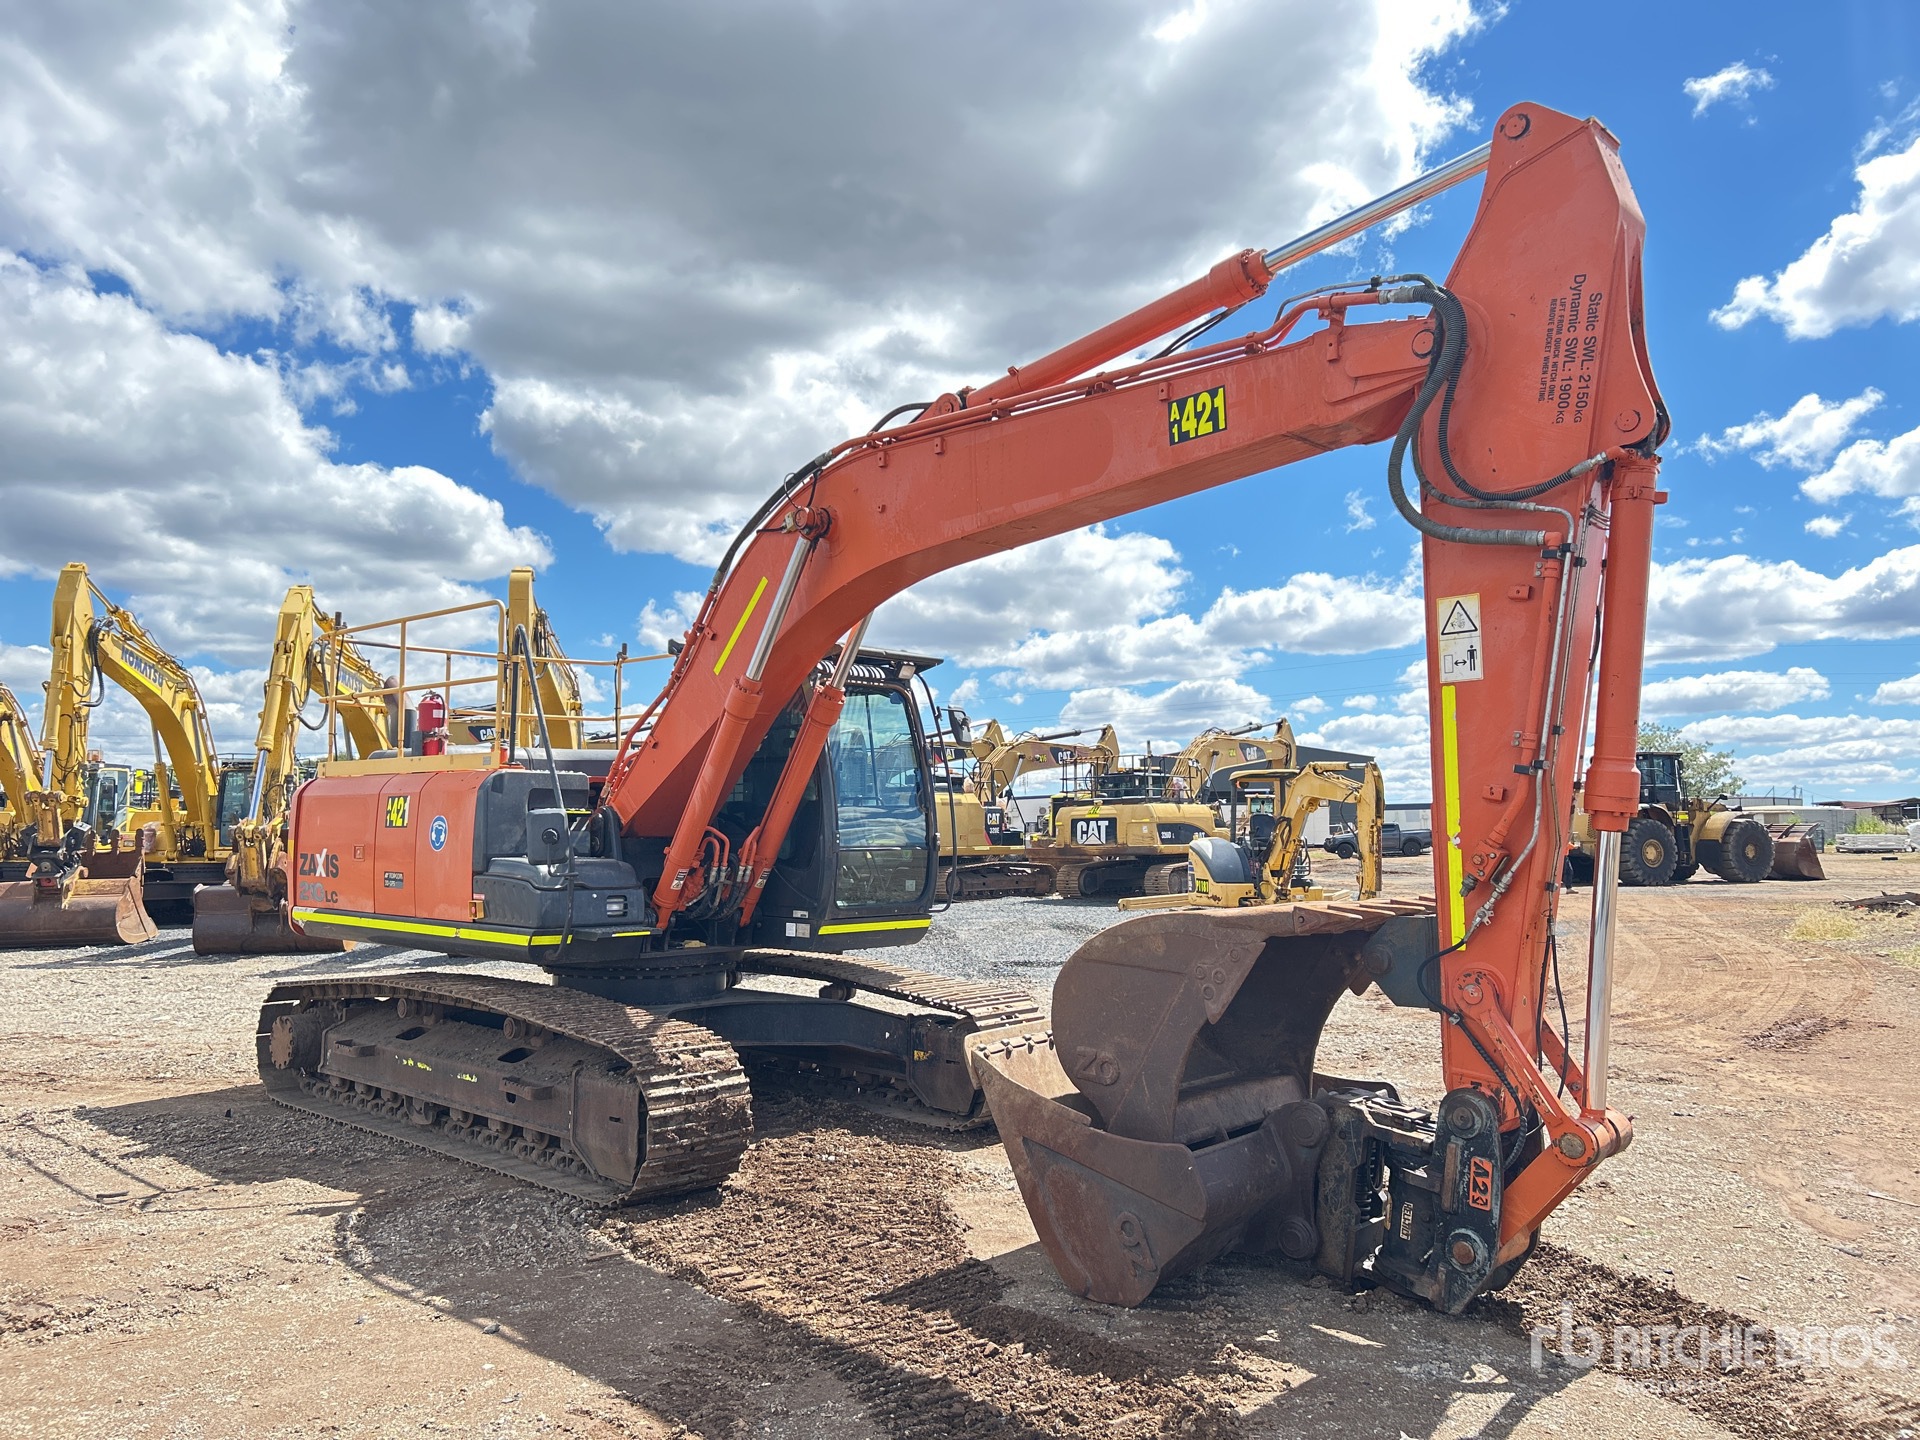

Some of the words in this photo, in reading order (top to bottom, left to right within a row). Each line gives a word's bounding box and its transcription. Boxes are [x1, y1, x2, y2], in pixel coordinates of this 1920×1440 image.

[1548, 298, 1558, 326] REMOVE
[1559, 297, 1567, 313] LIFT
[1567, 274, 1587, 333] Dynamic
[1585, 293, 1602, 332] Static
[1556, 314, 1565, 336] FROM
[1544, 328, 1554, 353] BUCKET
[1552, 337, 1562, 359] QUICK
[1541, 355, 1550, 375] WHEN
[1562, 337, 1578, 372] SWL:
[1580, 336, 1597, 371] SWL:
[1549, 361, 1559, 383] HITCH
[1181, 387, 1226, 438] 421
[121, 645, 163, 688] KOMATSU
[1058, 750, 1071, 765] CAT
[1246, 747, 1257, 760] CAT
[987, 813, 1000, 825] CAT
[1076, 820, 1109, 845] CAT
[299, 848, 339, 878] ZAXIS
